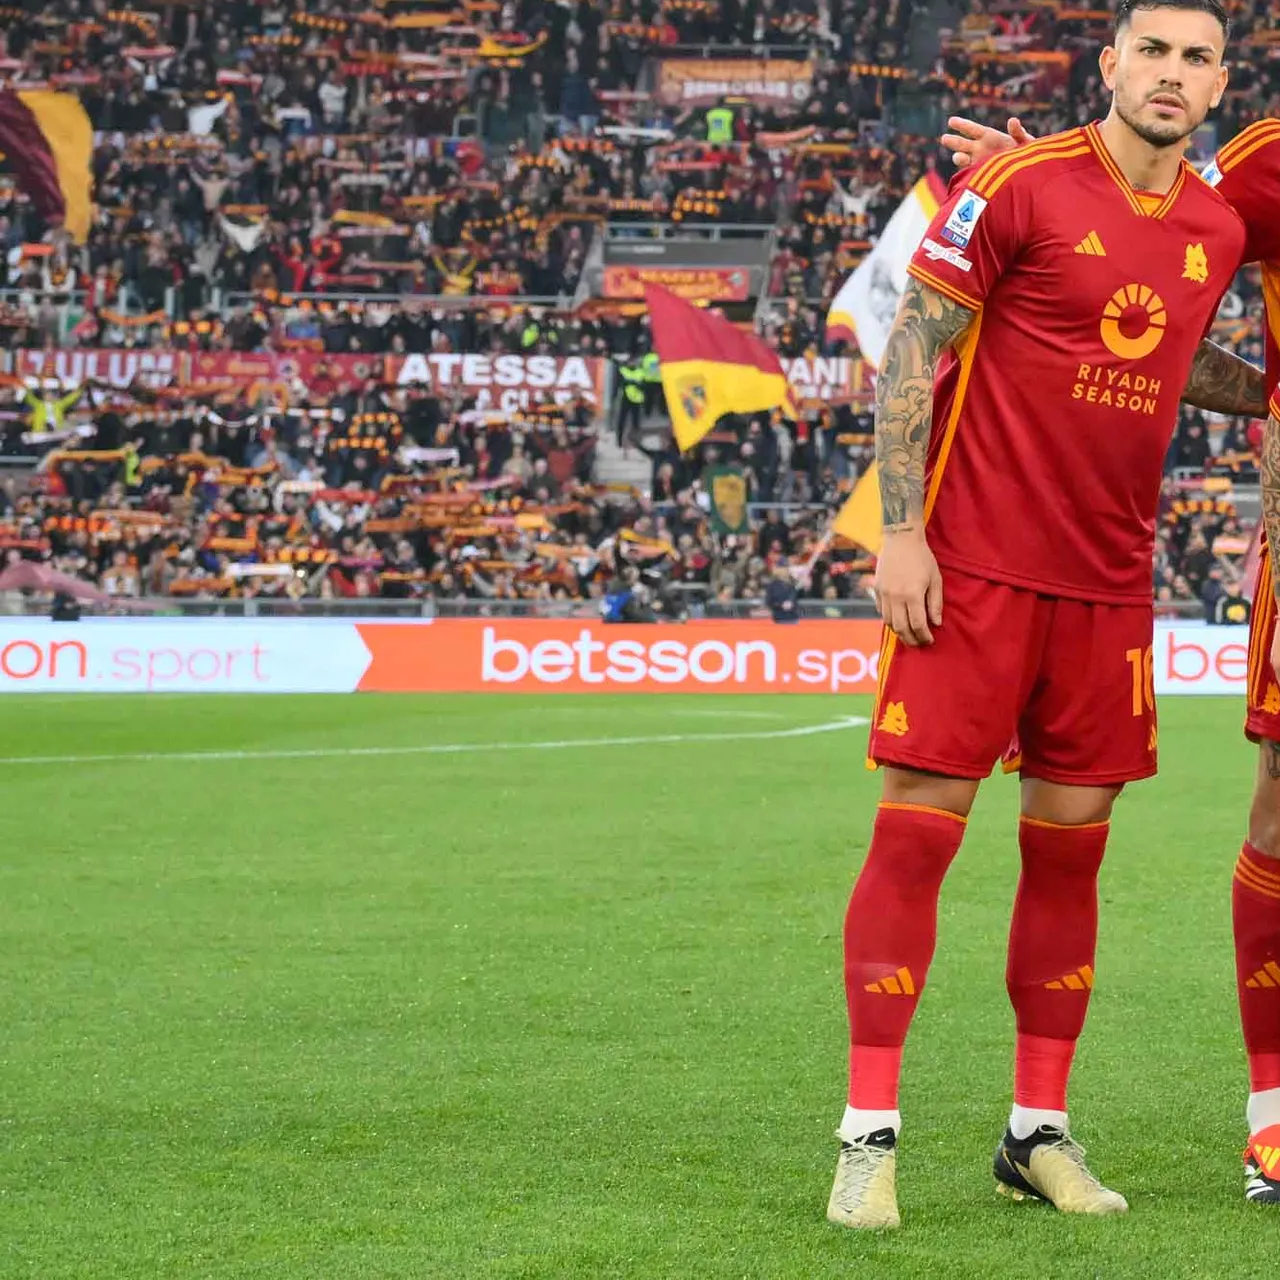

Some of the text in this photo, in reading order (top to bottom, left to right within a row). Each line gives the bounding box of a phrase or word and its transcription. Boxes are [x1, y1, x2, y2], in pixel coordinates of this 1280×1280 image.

[397, 353, 593, 388] ATESSA
[1077, 363, 1161, 395] RIYADH
[1072, 383, 1157, 415] SEASON
